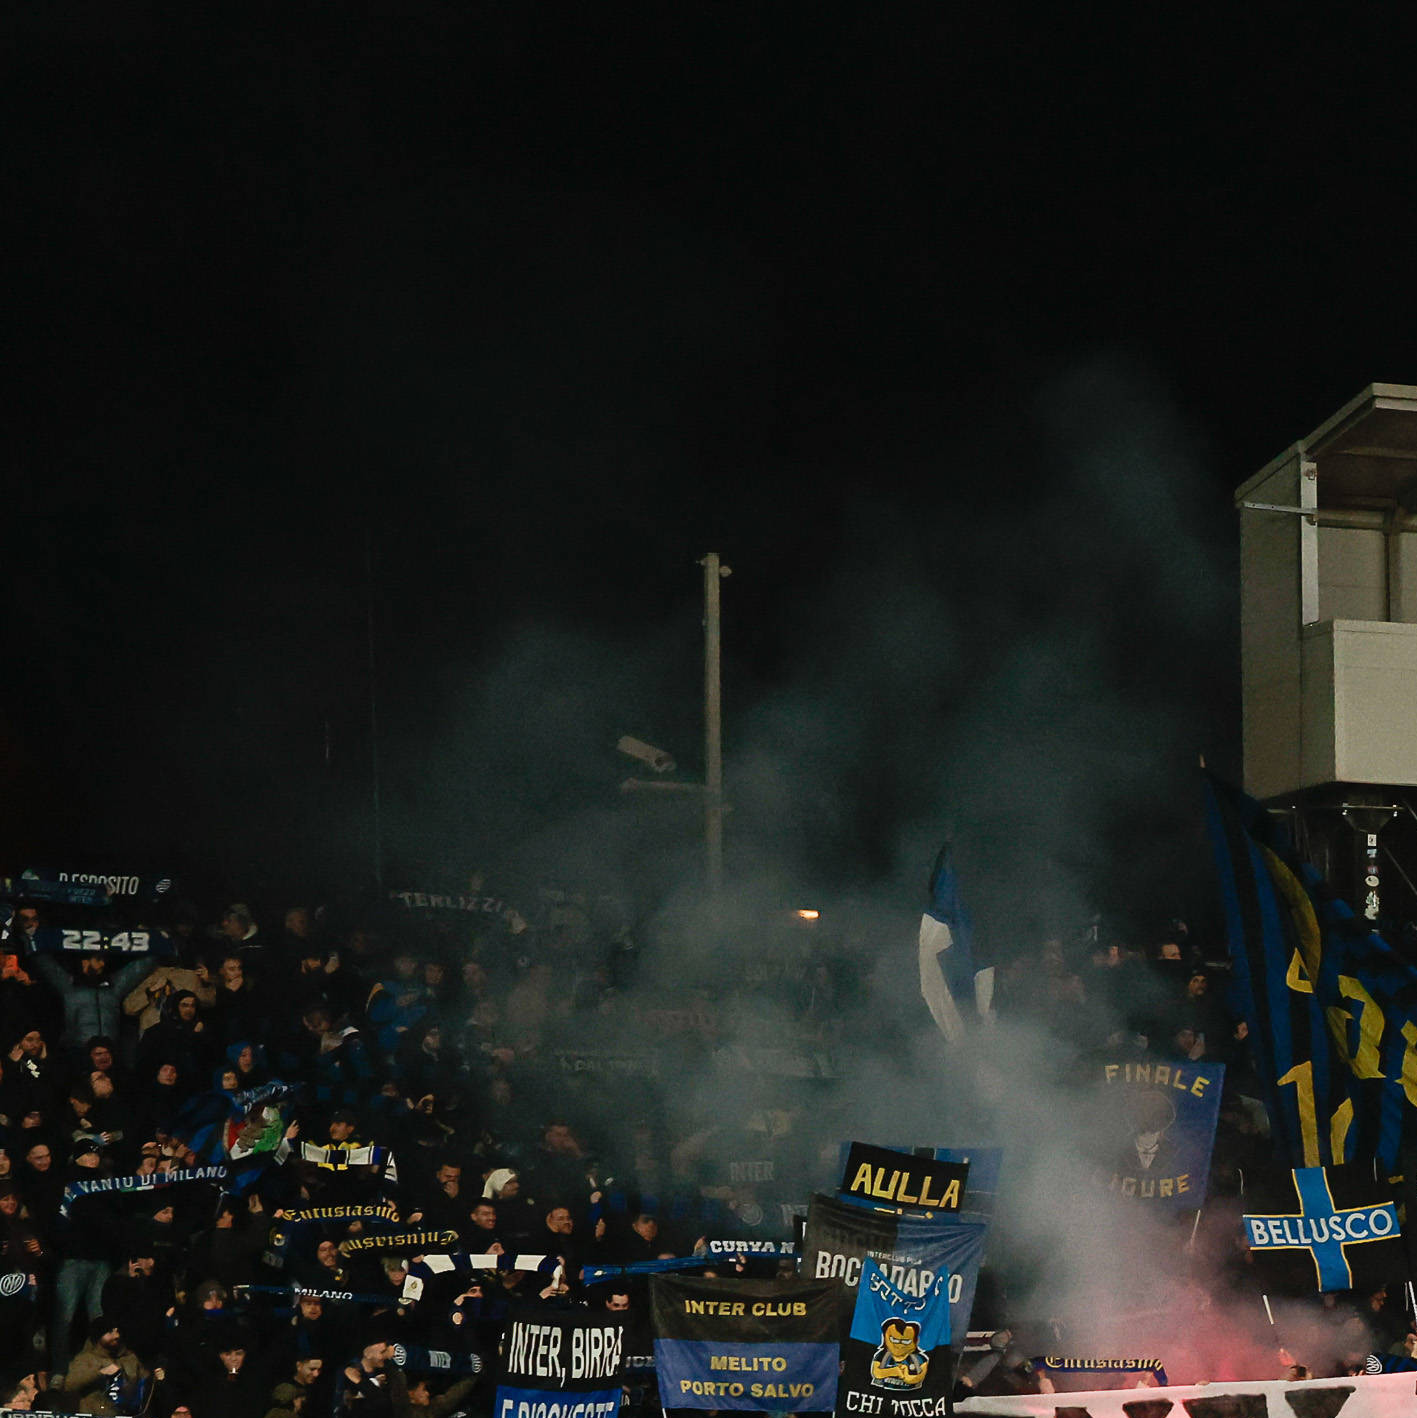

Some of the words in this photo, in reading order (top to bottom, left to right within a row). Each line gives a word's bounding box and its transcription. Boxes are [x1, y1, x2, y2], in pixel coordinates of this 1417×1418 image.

[62, 929, 150, 953] 22:43
[1104, 1063, 1210, 1098] FINALE
[850, 1163, 962, 1209] AULLA
[1251, 1208, 1393, 1247] BELLUSCO
[293, 1288, 353, 1301] MILANO
[685, 1299, 747, 1317] INTER
[751, 1298, 807, 1318] CLUB
[571, 1324, 623, 1380] BIRRA
[710, 1354, 788, 1373] MELITO
[679, 1380, 744, 1398] PORTO
[749, 1381, 815, 1398] SALVO
[846, 1391, 883, 1415] CHI
[891, 1395, 946, 1417] TOCCA
